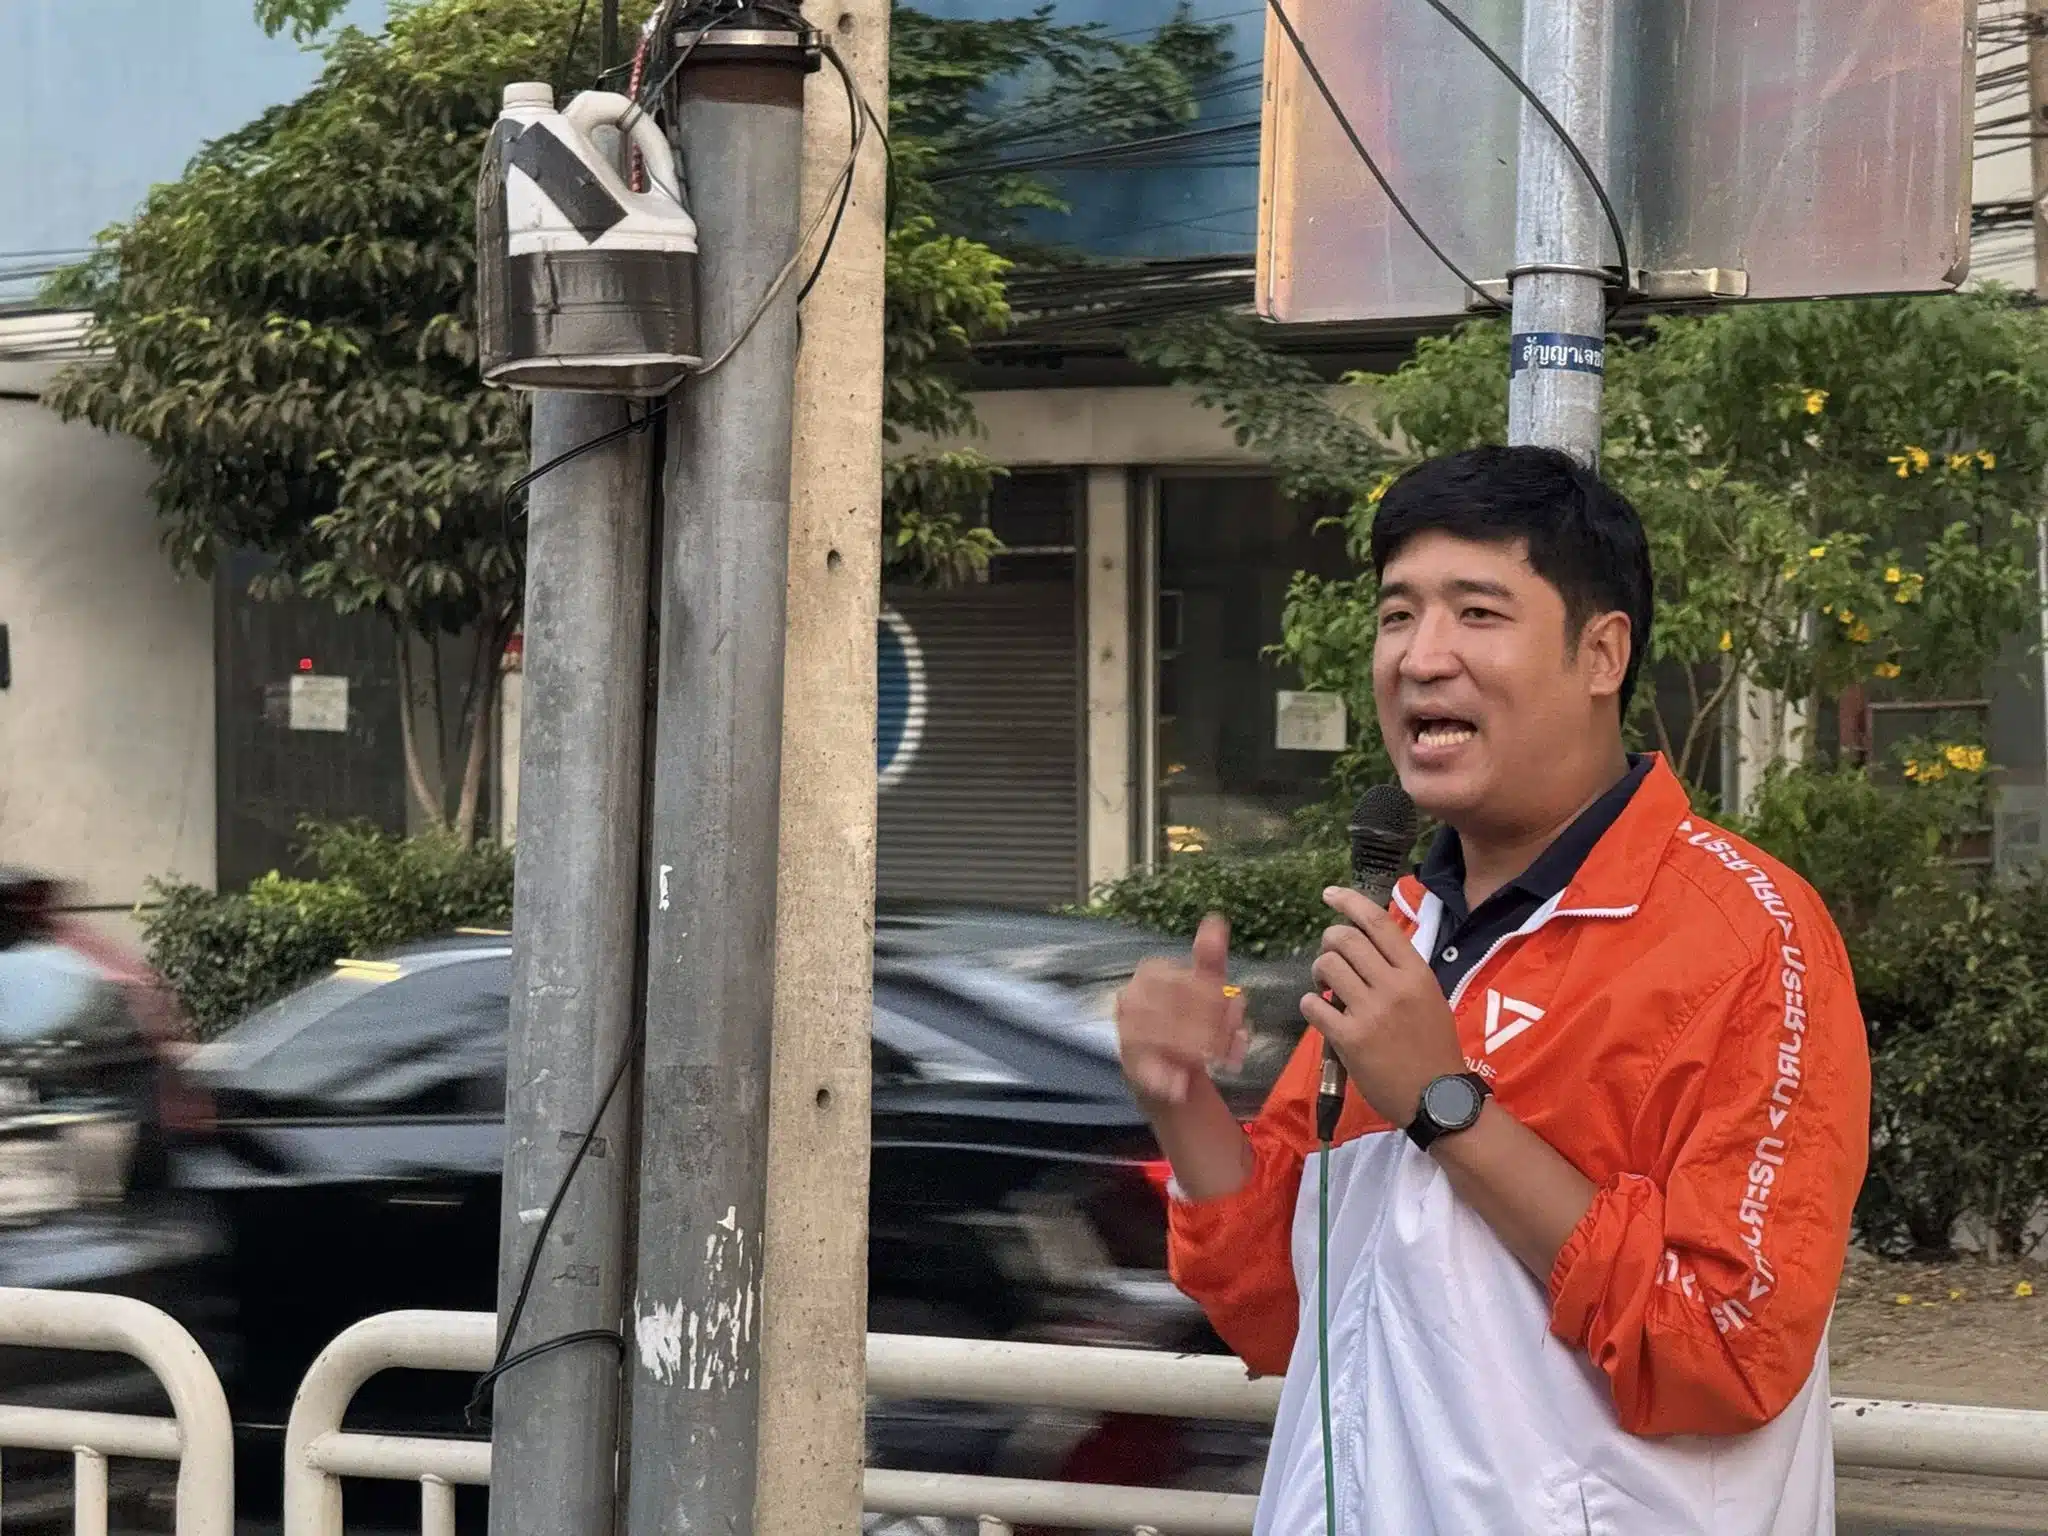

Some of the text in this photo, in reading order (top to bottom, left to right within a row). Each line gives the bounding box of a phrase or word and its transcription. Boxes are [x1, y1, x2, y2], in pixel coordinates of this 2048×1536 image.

[1523, 336, 1604, 368] สัญญาเลข
[1772, 945, 1807, 1105] ประชาชน
